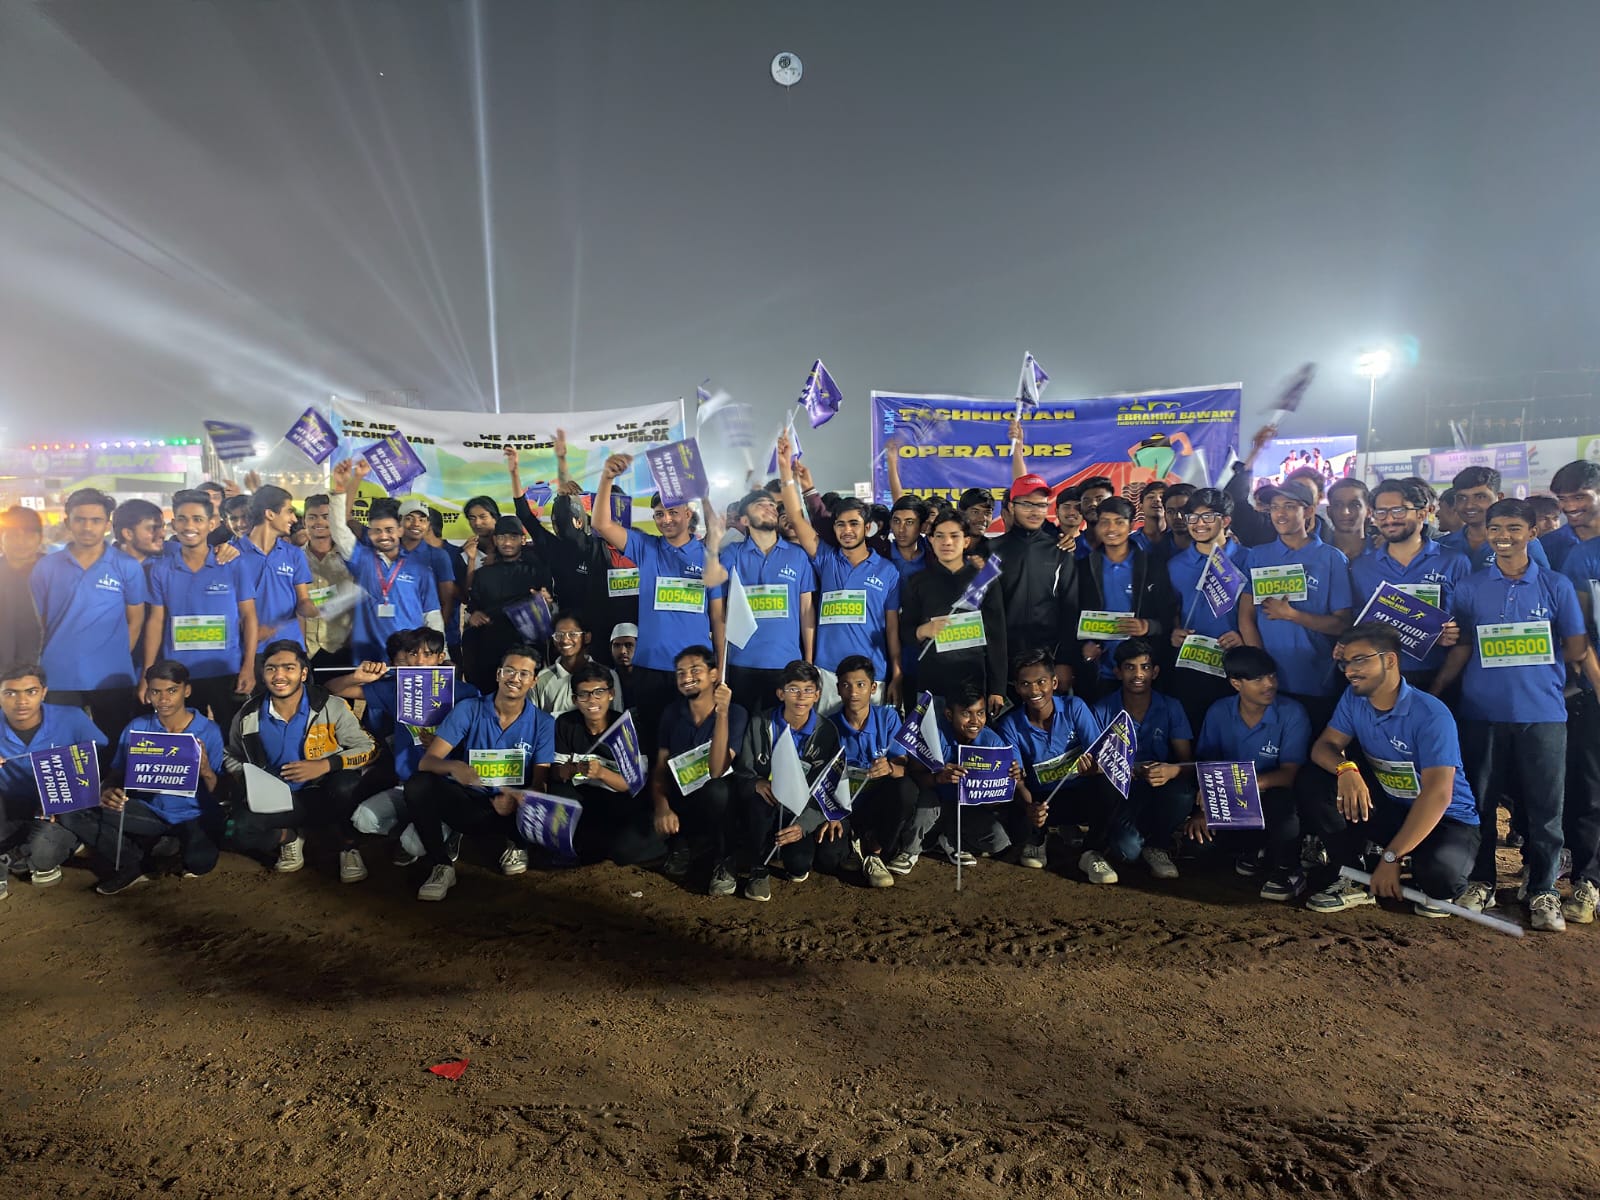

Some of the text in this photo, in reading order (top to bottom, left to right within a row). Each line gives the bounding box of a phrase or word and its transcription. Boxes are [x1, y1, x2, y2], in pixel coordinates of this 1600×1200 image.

[898, 408, 1076, 422] TECHNICIAN
[1118, 410, 1237, 421] EBRAHIM BAWANY
[342, 420, 397, 432] WE ARE
[615, 418, 670, 431] WE ARE
[479, 434, 502, 442] WE
[590, 427, 670, 443] FUTURE OF
[627, 434, 670, 444] INDIA
[463, 441, 555, 451] OPERATORS
[899, 443, 1073, 459] OPERATORS
[376, 447, 386, 458] MY
[382, 456, 402, 482] STRIDE
[653, 457, 663, 470] MY
[663, 451, 672, 465] MY
[369, 454, 380, 466] MY
[376, 464, 394, 485] PRIDE
[666, 465, 684, 497] STRIDE
[901, 487, 1006, 502] FUTUE
[612, 578, 640, 590] 00547
[1208, 575, 1232, 604] STRIDE
[1257, 579, 1303, 595] 005482
[660, 590, 702, 604] 005449
[1206, 584, 1225, 608] PRIDE
[823, 602, 863, 616] 005599
[1373, 611, 1431, 641] MY STRIDE
[177, 628, 223, 641] 005495
[938, 624, 981, 643] 005598
[1484, 638, 1547, 657] 005600
[403, 677, 413, 719] MY PRIDE
[414, 674, 424, 721] MY STRIDE
[903, 732, 917, 746] MY
[134, 763, 191, 775] MY STRIDE
[39, 760, 60, 805] MY PRIDE
[51, 754, 73, 804] MY STRIDE
[136, 774, 187, 785] MY PRIDE
[966, 776, 1011, 788] MY STRIDE
[968, 787, 1008, 799] MY PRIDE
[1203, 773, 1221, 821] MY PRIDE
[1214, 769, 1232, 823] MY STRIDE
